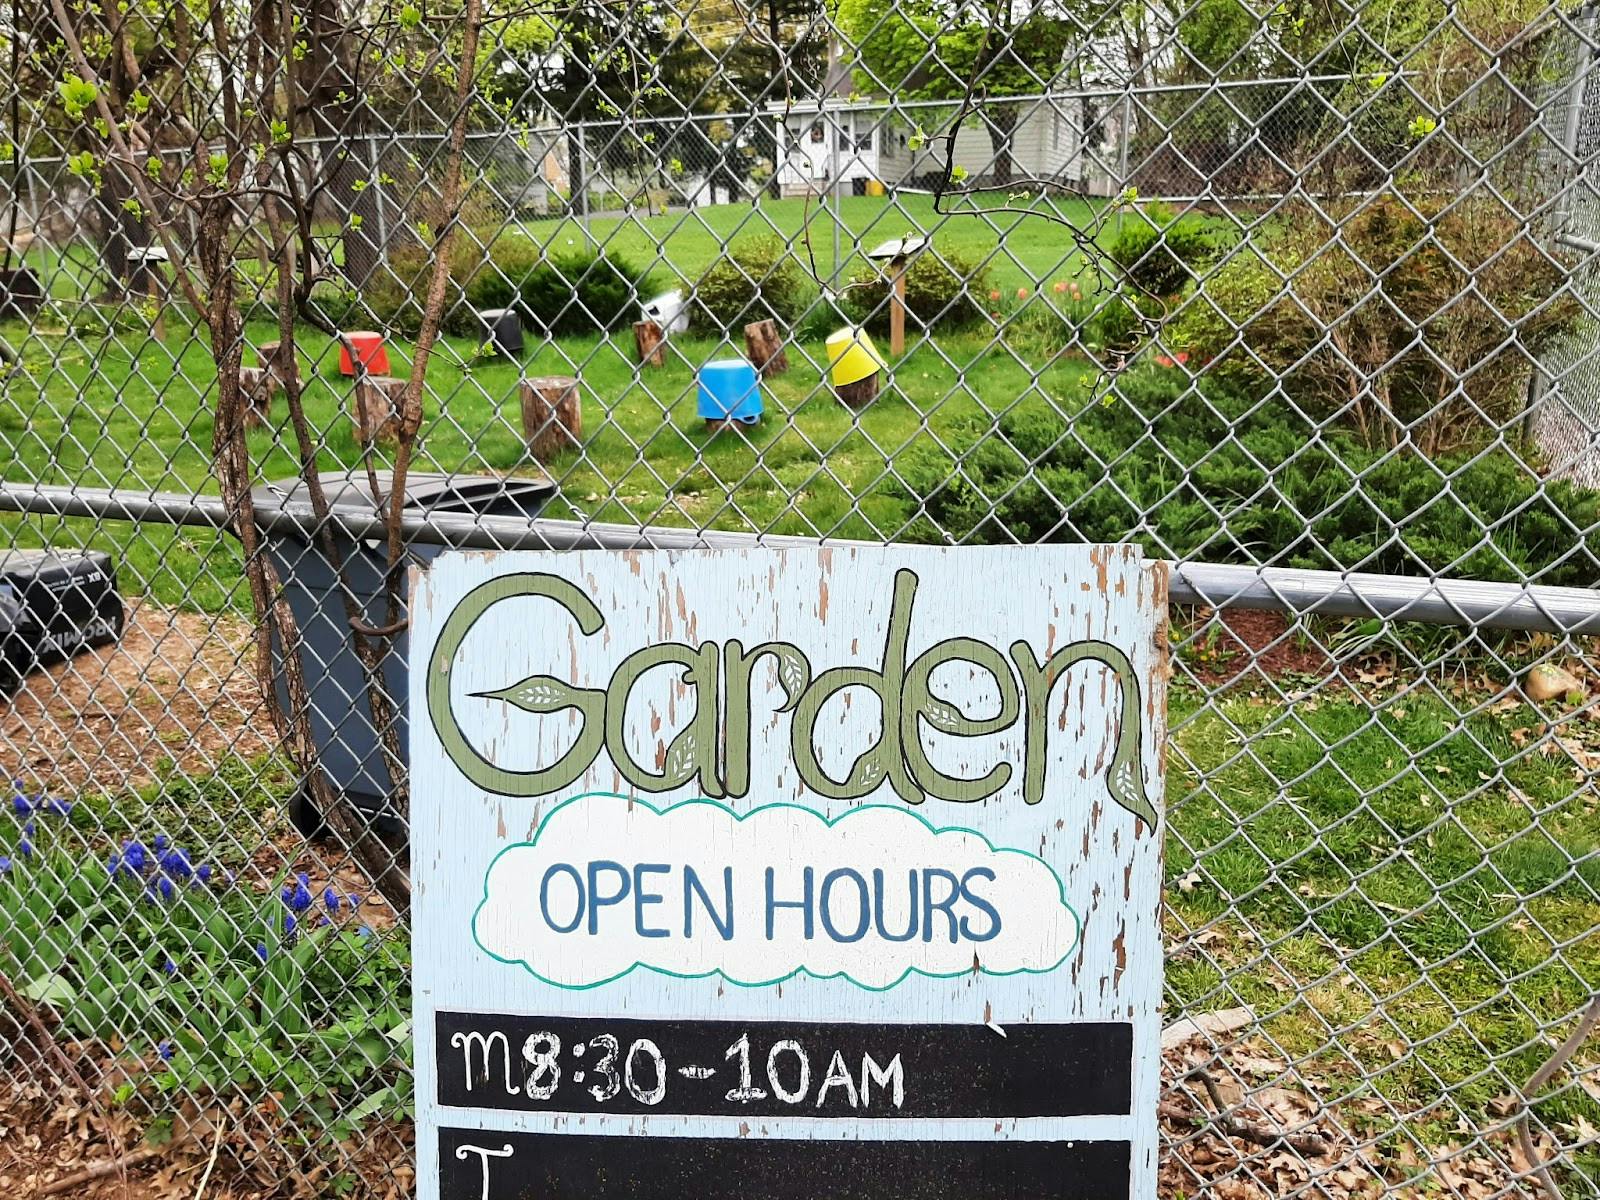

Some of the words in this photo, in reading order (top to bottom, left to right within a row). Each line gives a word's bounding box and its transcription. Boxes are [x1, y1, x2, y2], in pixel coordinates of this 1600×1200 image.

[425, 567, 1158, 836] Garden
[539, 860, 734, 941] OPEN
[764, 865, 1002, 943] HOURS
[455, 1143, 515, 1200] T
